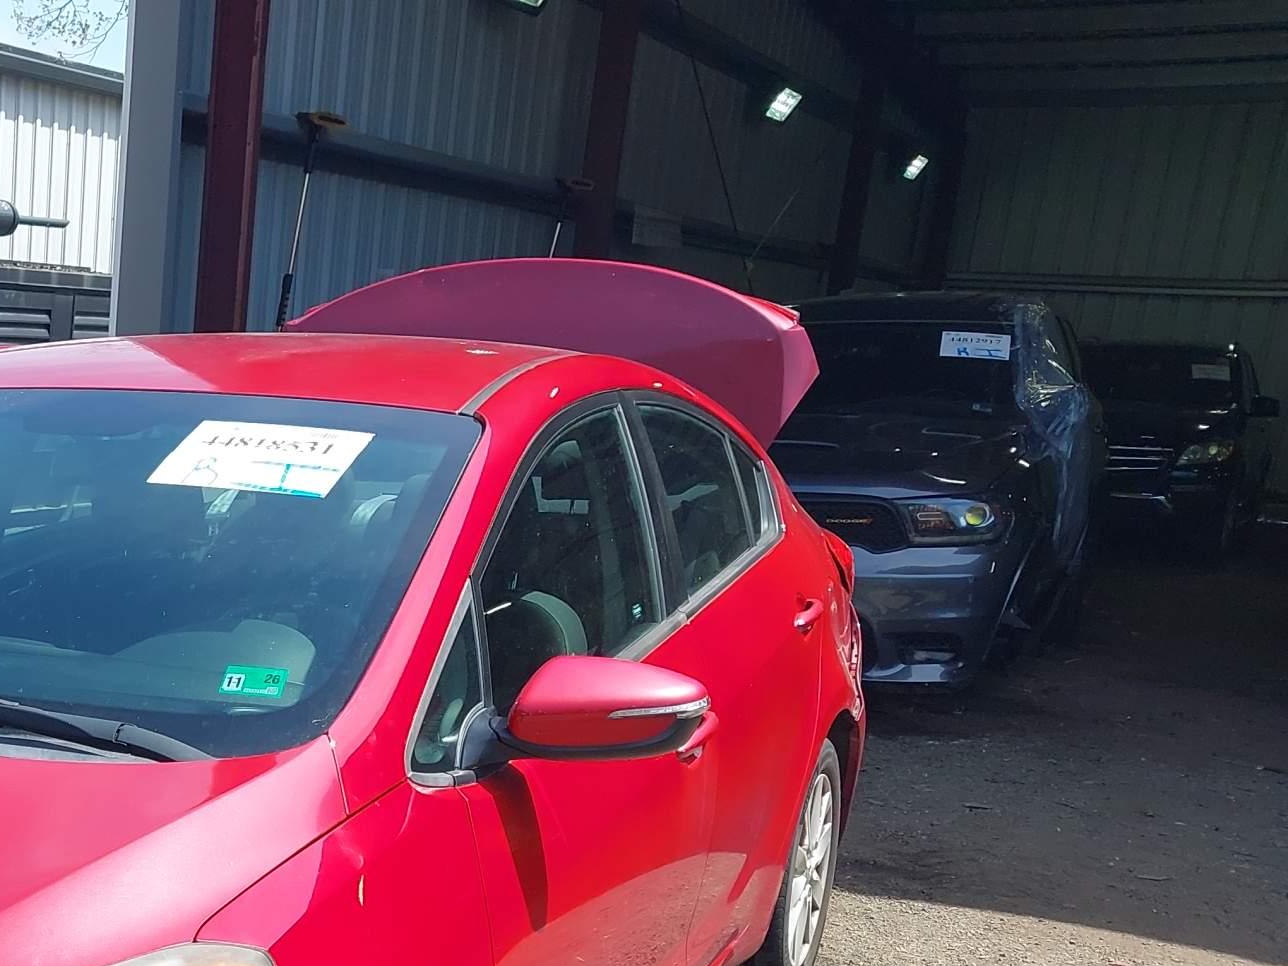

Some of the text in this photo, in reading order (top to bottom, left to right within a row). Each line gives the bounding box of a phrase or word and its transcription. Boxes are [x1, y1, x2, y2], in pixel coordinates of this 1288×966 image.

[202, 435, 334, 455] 44818531
[225, 673, 281, 689] 11 26
